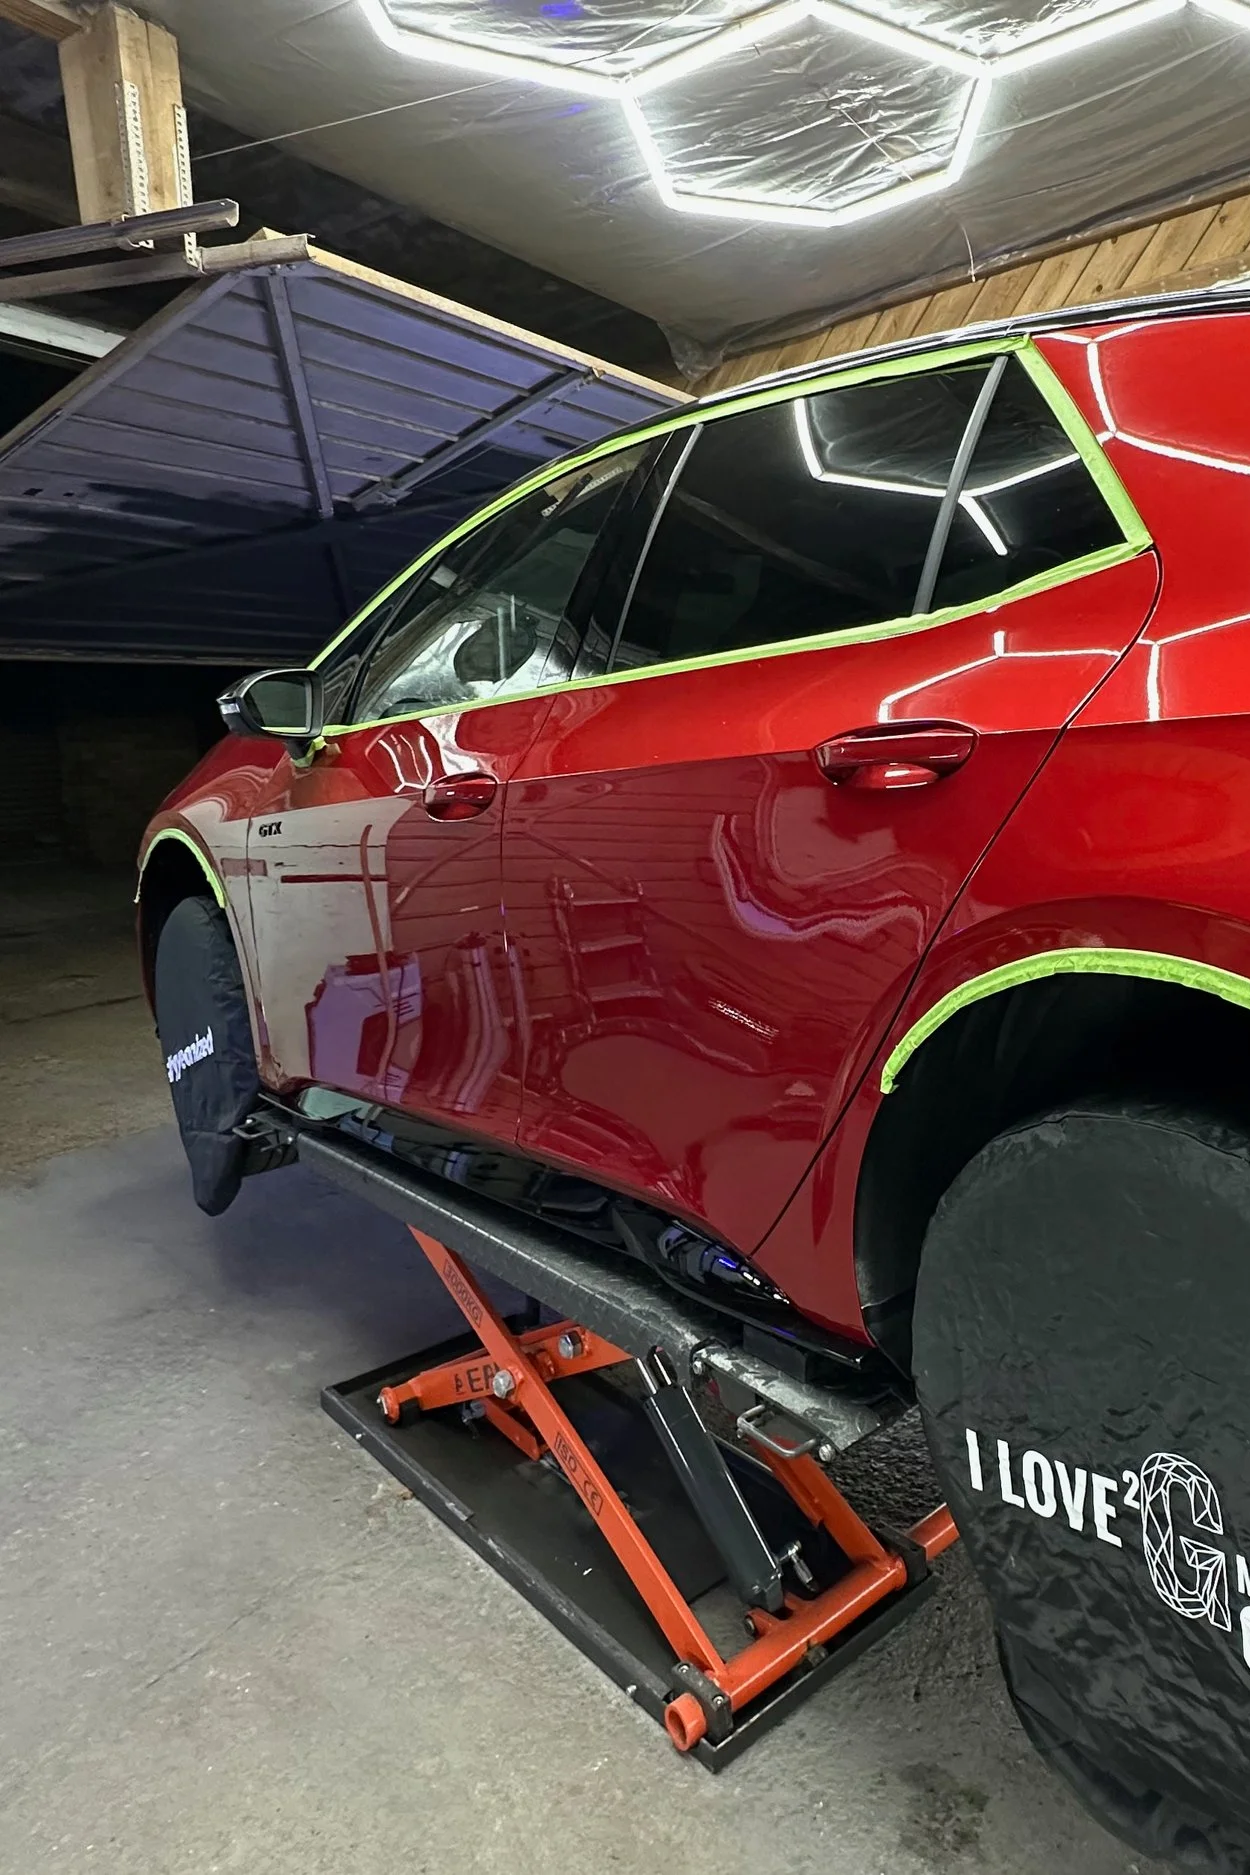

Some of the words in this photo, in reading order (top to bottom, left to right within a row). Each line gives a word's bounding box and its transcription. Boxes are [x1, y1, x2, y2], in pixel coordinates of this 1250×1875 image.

[259, 821, 282, 837] GTX
[555, 1438, 577, 1473] ISO
[965, 1428, 983, 1491] I
[997, 1439, 1122, 1548] LOVE
